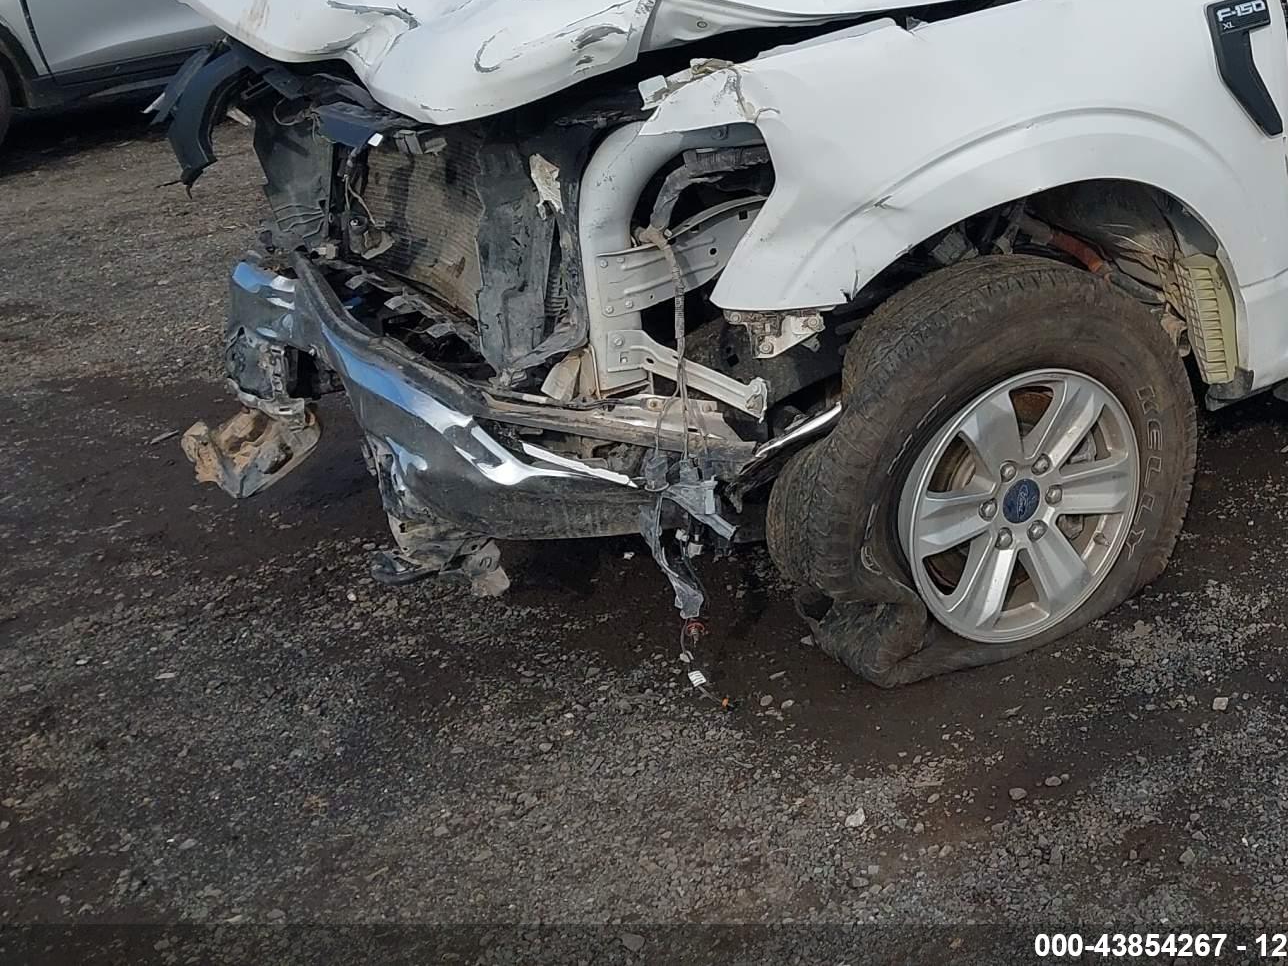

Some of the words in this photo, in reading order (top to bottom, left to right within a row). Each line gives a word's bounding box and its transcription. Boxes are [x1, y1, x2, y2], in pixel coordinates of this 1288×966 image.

[1216, 0, 1266, 22] F-150
[1222, 21, 1236, 30] XL
[1126, 384, 1163, 562] KELLY
